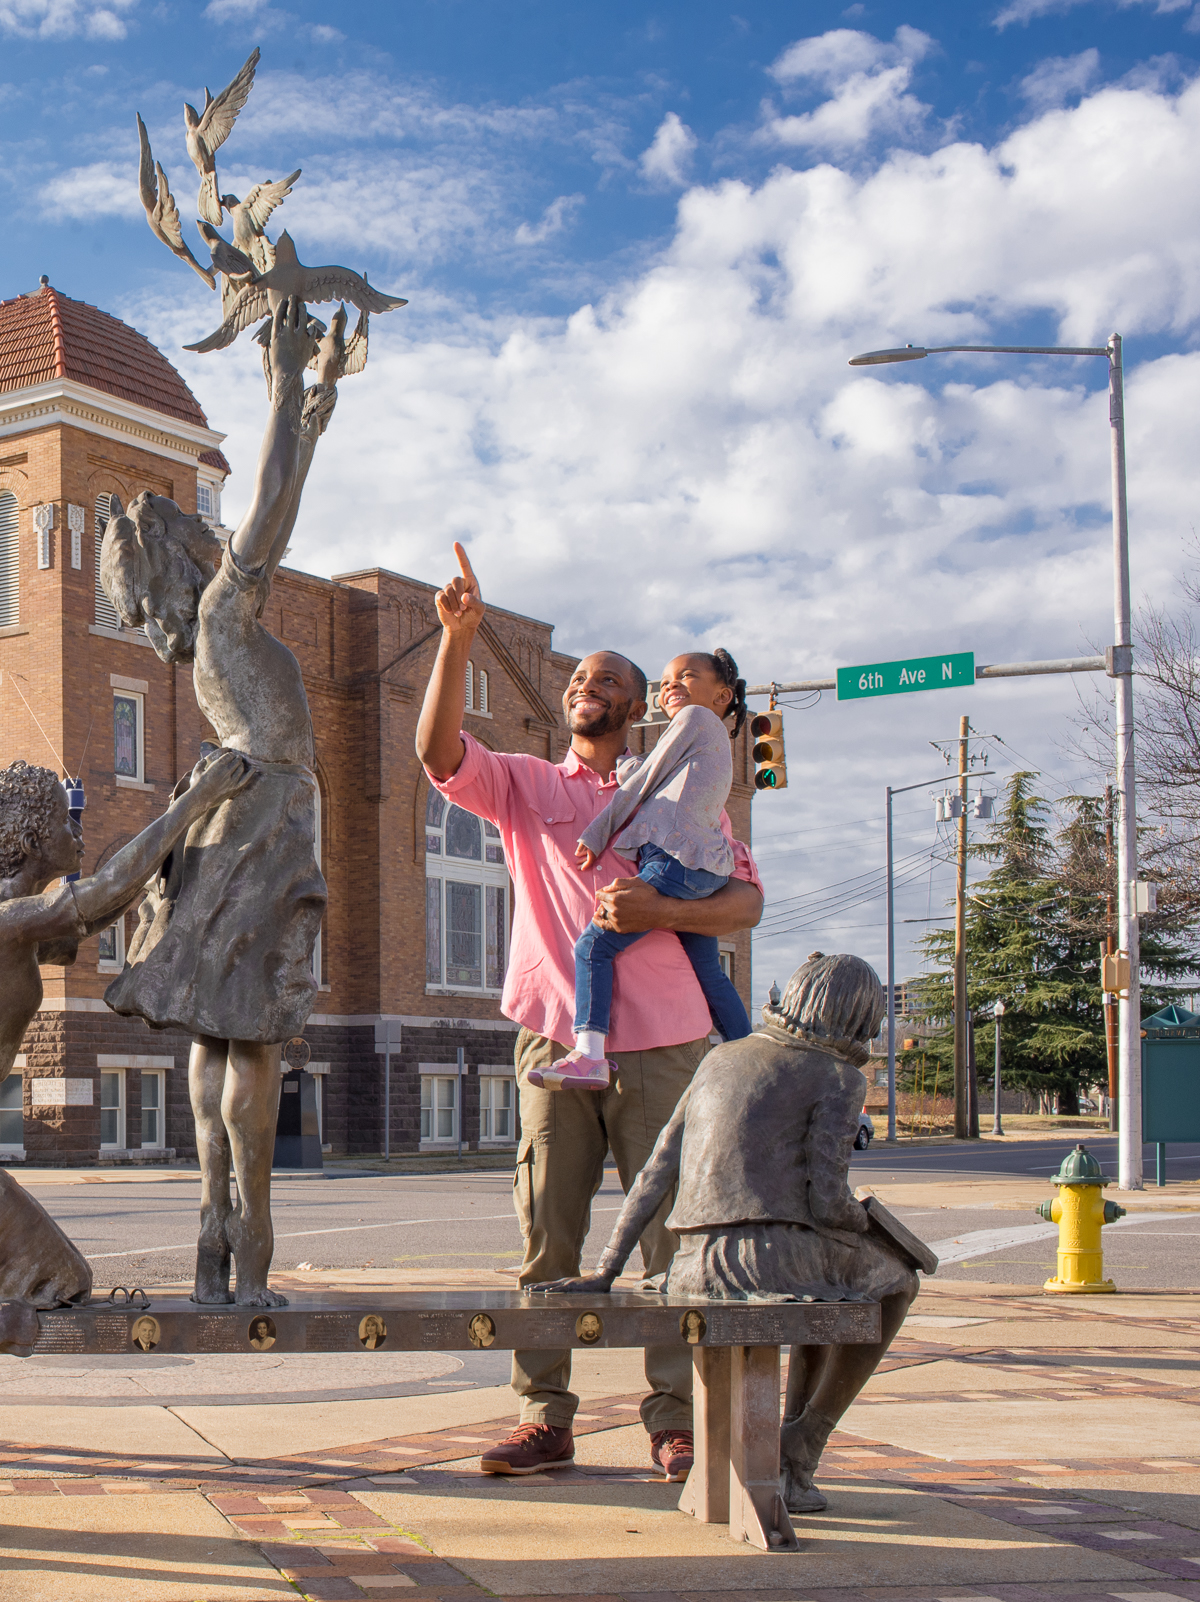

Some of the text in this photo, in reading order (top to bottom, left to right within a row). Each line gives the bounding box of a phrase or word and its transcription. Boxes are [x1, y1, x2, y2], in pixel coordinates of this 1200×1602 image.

[858, 662, 952, 690] 6th Ave N
